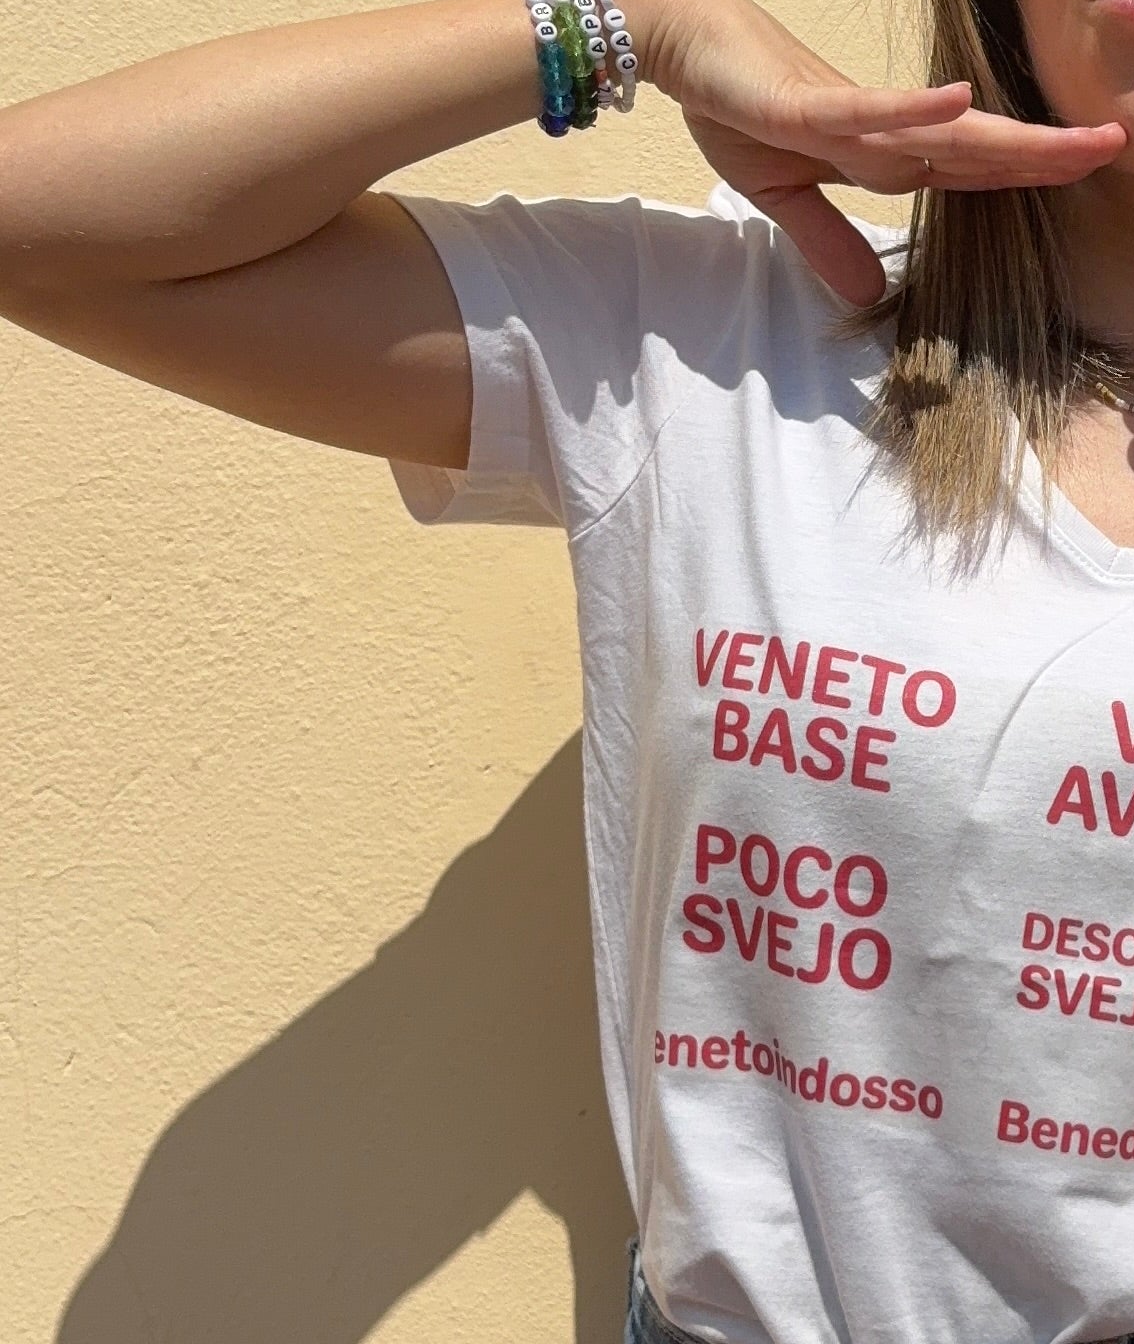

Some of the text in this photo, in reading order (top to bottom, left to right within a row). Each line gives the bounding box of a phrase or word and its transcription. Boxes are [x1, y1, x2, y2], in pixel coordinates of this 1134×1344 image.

[695, 629, 958, 729] VENETO
[712, 698, 897, 794] BASE
[694, 823, 889, 919] POCO
[682, 893, 893, 992] SVEJO
